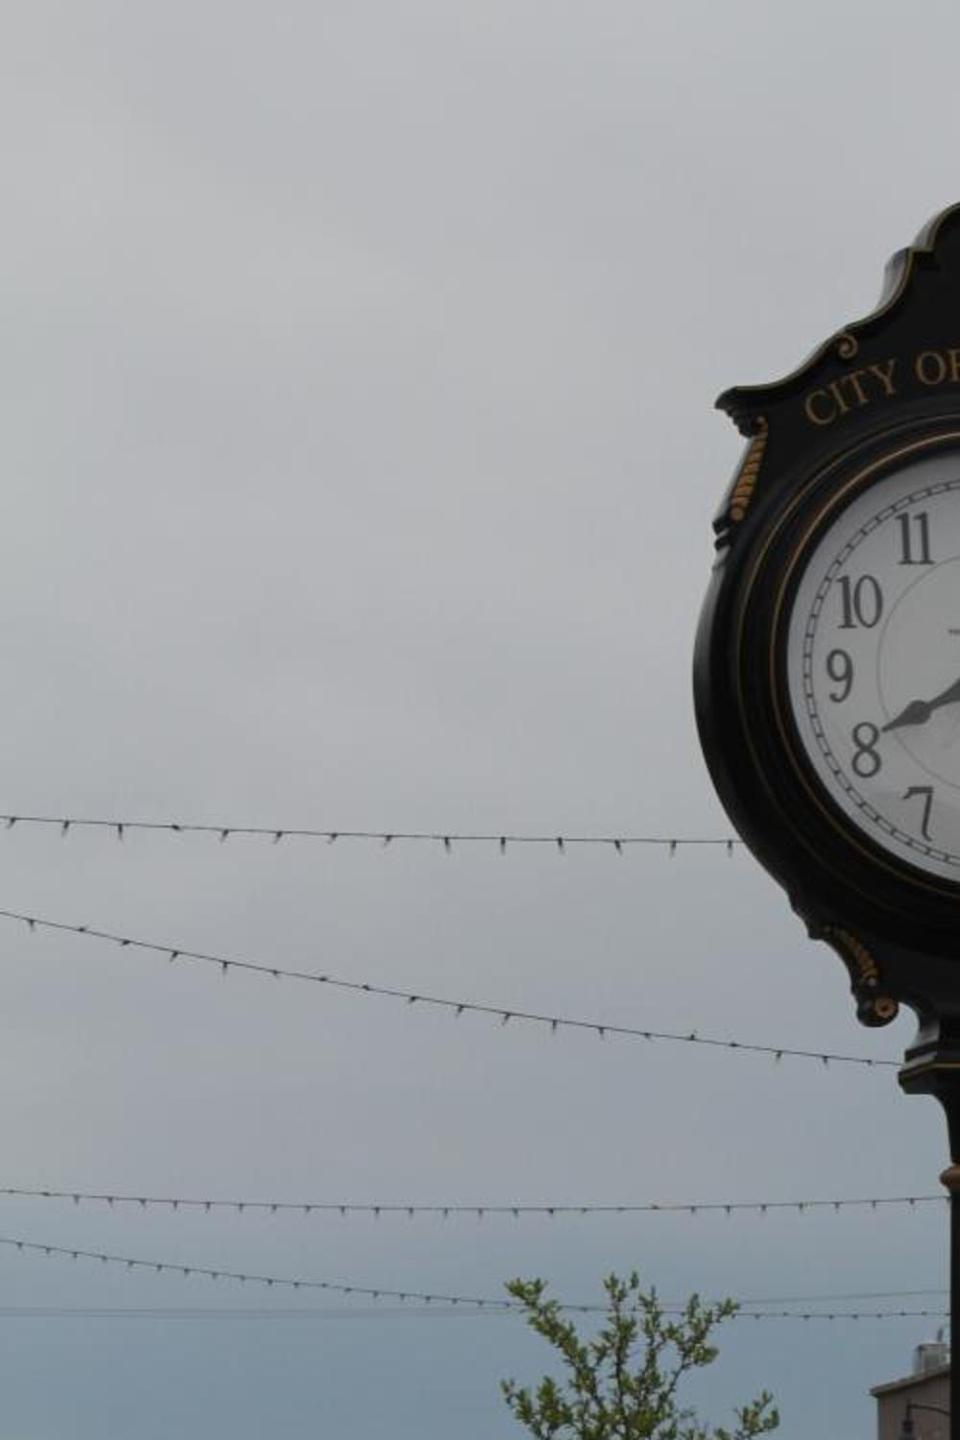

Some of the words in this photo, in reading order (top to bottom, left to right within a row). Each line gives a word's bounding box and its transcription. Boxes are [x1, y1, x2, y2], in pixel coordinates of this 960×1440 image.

[804, 359, 900, 425] CITY
[896, 511, 936, 565] 11
[836, 574, 884, 629] 10
[826, 648, 854, 703] 9
[851, 721, 883, 778] 8
[902, 785, 935, 842] 7
